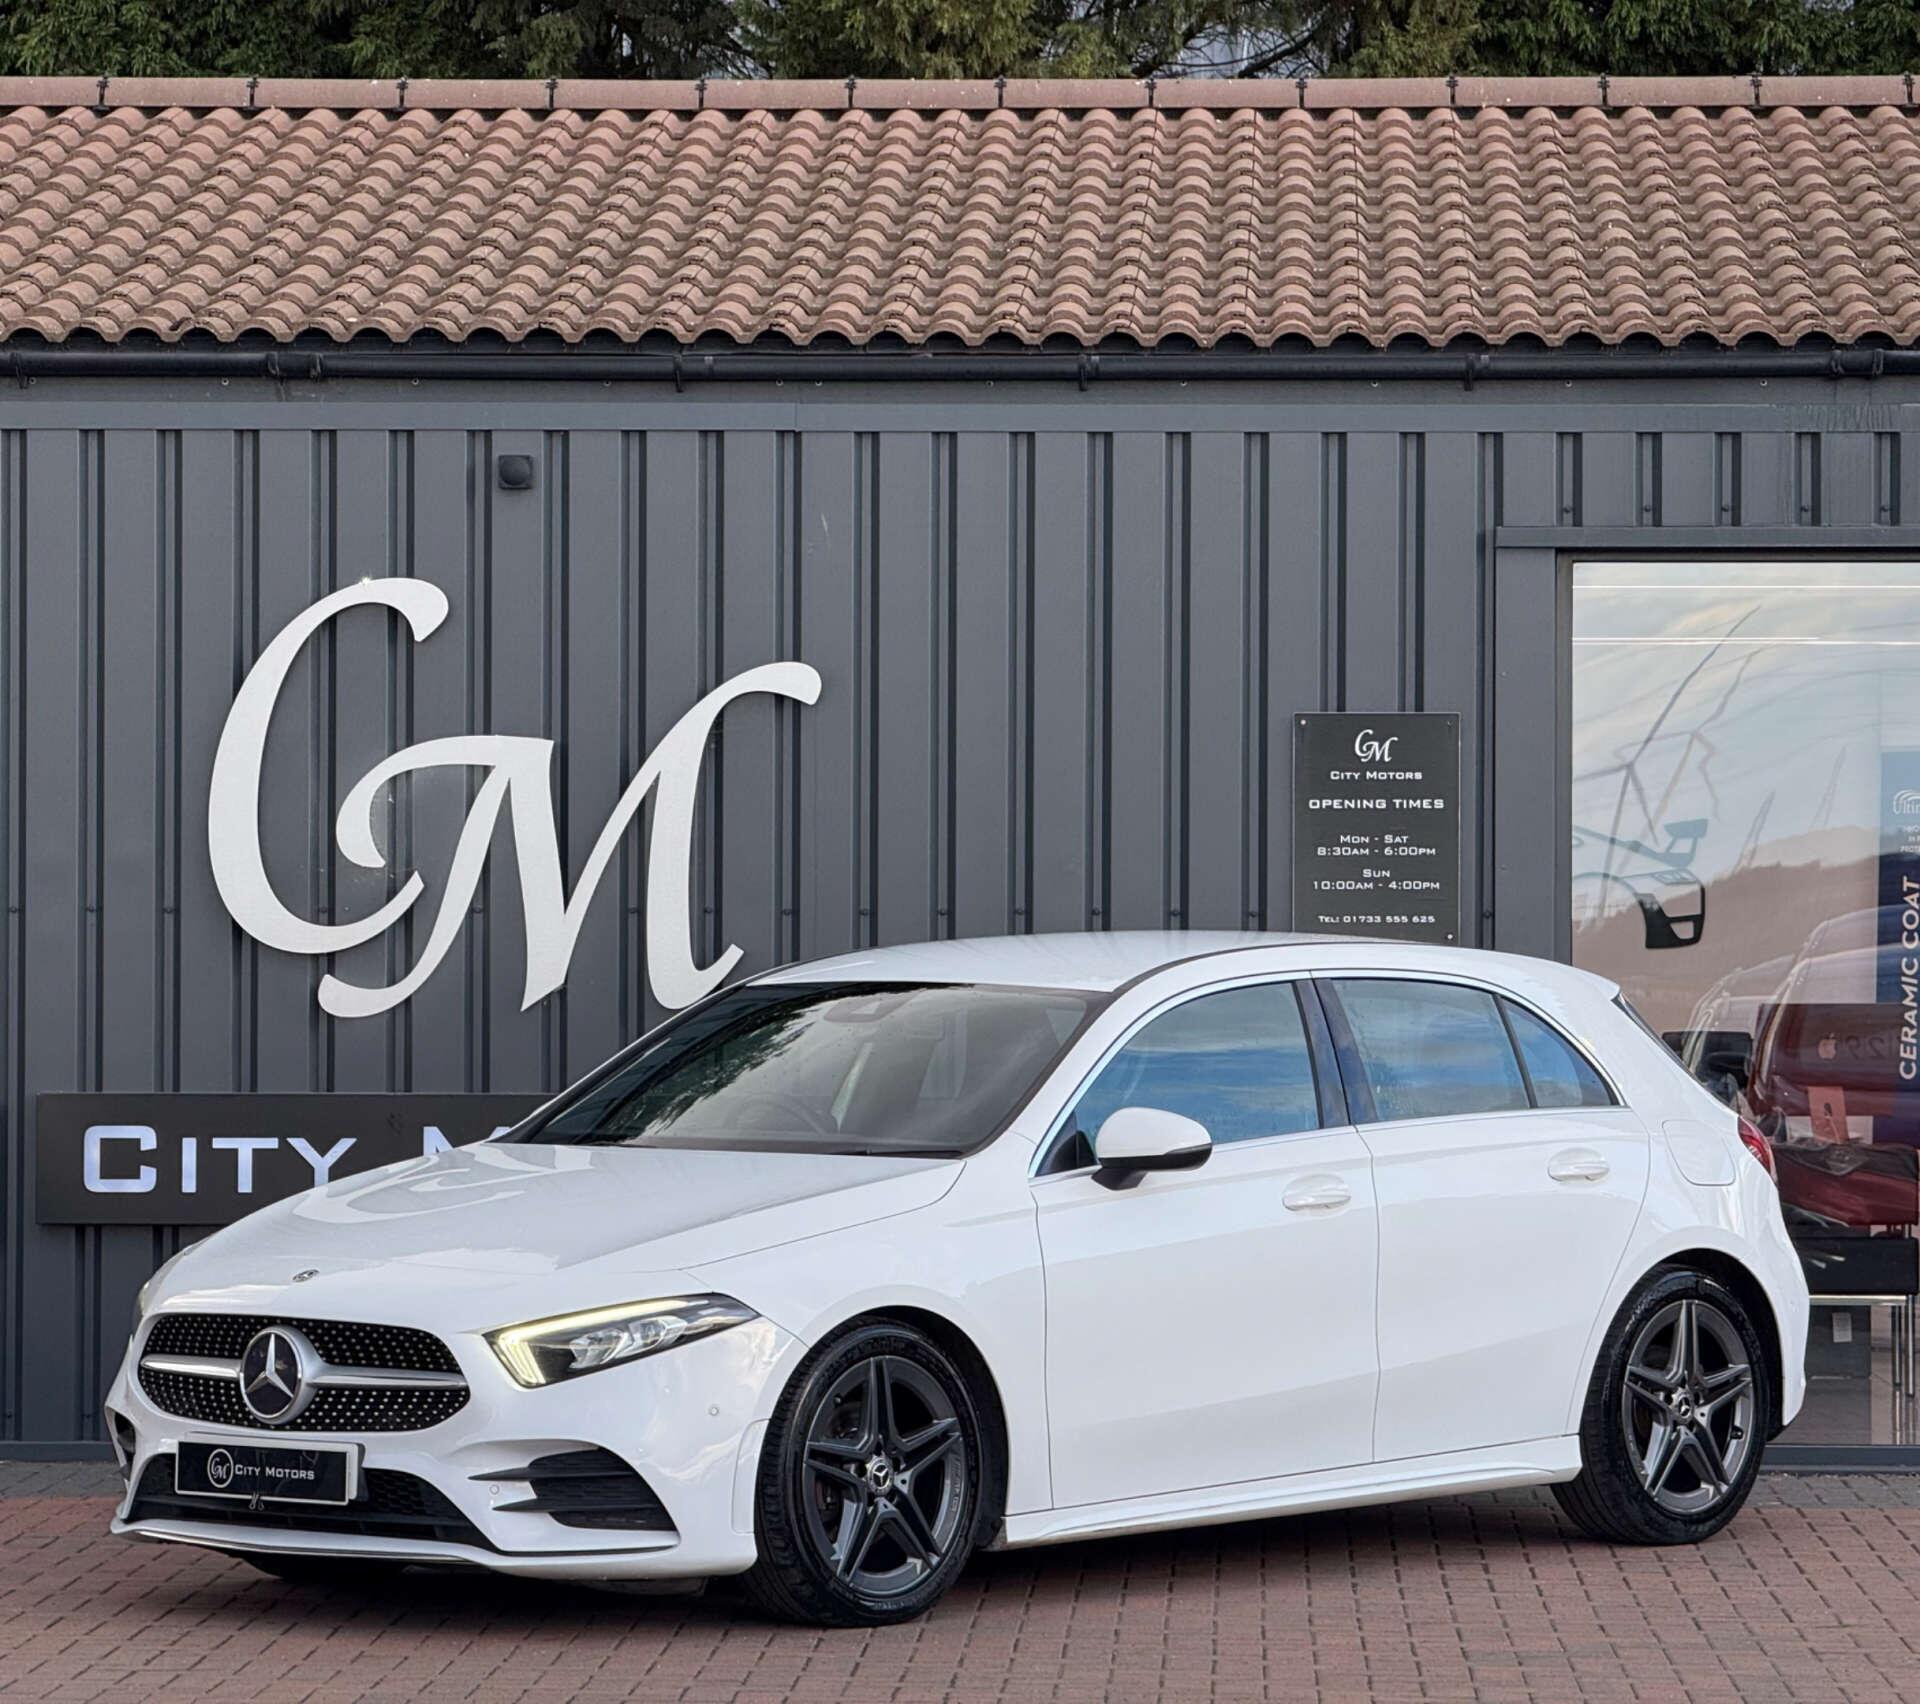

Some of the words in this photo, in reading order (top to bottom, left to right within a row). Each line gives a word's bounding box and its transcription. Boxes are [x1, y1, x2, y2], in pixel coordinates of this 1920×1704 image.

[1330, 770, 1360, 780] CITY
[1366, 770, 1422, 780] MOTORS
[1308, 799, 1387, 809] OPENING
[1392, 799, 1444, 809] TIMES
[1340, 834, 1369, 844] MON
[1384, 834, 1408, 844] SAT
[1317, 847, 1369, 856] 8:30AM
[1384, 847, 1436, 856] 6:00PM
[1362, 869, 1390, 878] SUN
[1313, 881, 1373, 890] 10:00AM
[1388, 881, 1440, 890] 4:00PM
[1902, 875, 1920, 950] COAT
[1343, 915, 1381, 923] 01733
[1899, 956, 1919, 1080] CERAMIC
[83, 1125, 357, 1193] CITY
[235, 1464, 261, 1477] CITY
[265, 1466, 315, 1481] MOTORS
